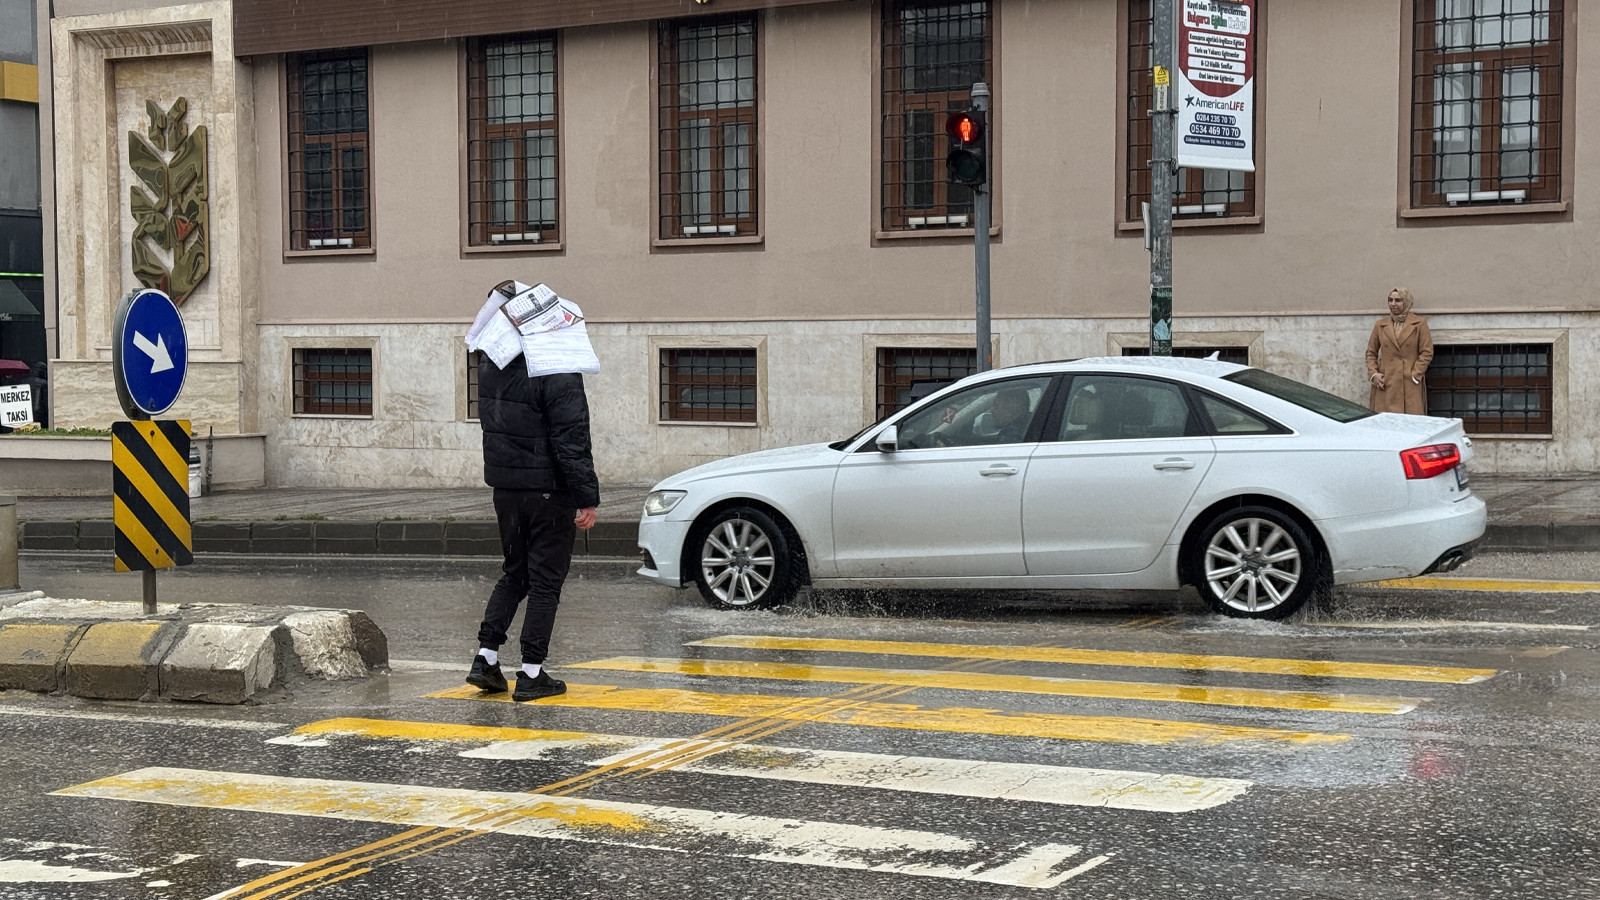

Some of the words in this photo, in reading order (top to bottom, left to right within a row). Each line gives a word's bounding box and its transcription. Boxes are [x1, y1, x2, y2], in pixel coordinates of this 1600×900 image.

[1196, 97, 1244, 111] AmericanLIFE
[1196, 114, 1209, 122] 0284
[1191, 125, 1207, 134] 0534
[1208, 126, 1220, 135] 469
[1222, 128, 1230, 136] 70
[1231, 128, 1239, 137] 70
[0, 391, 30, 403] MERKEZ
[6, 408, 28, 422] TAKSİ
